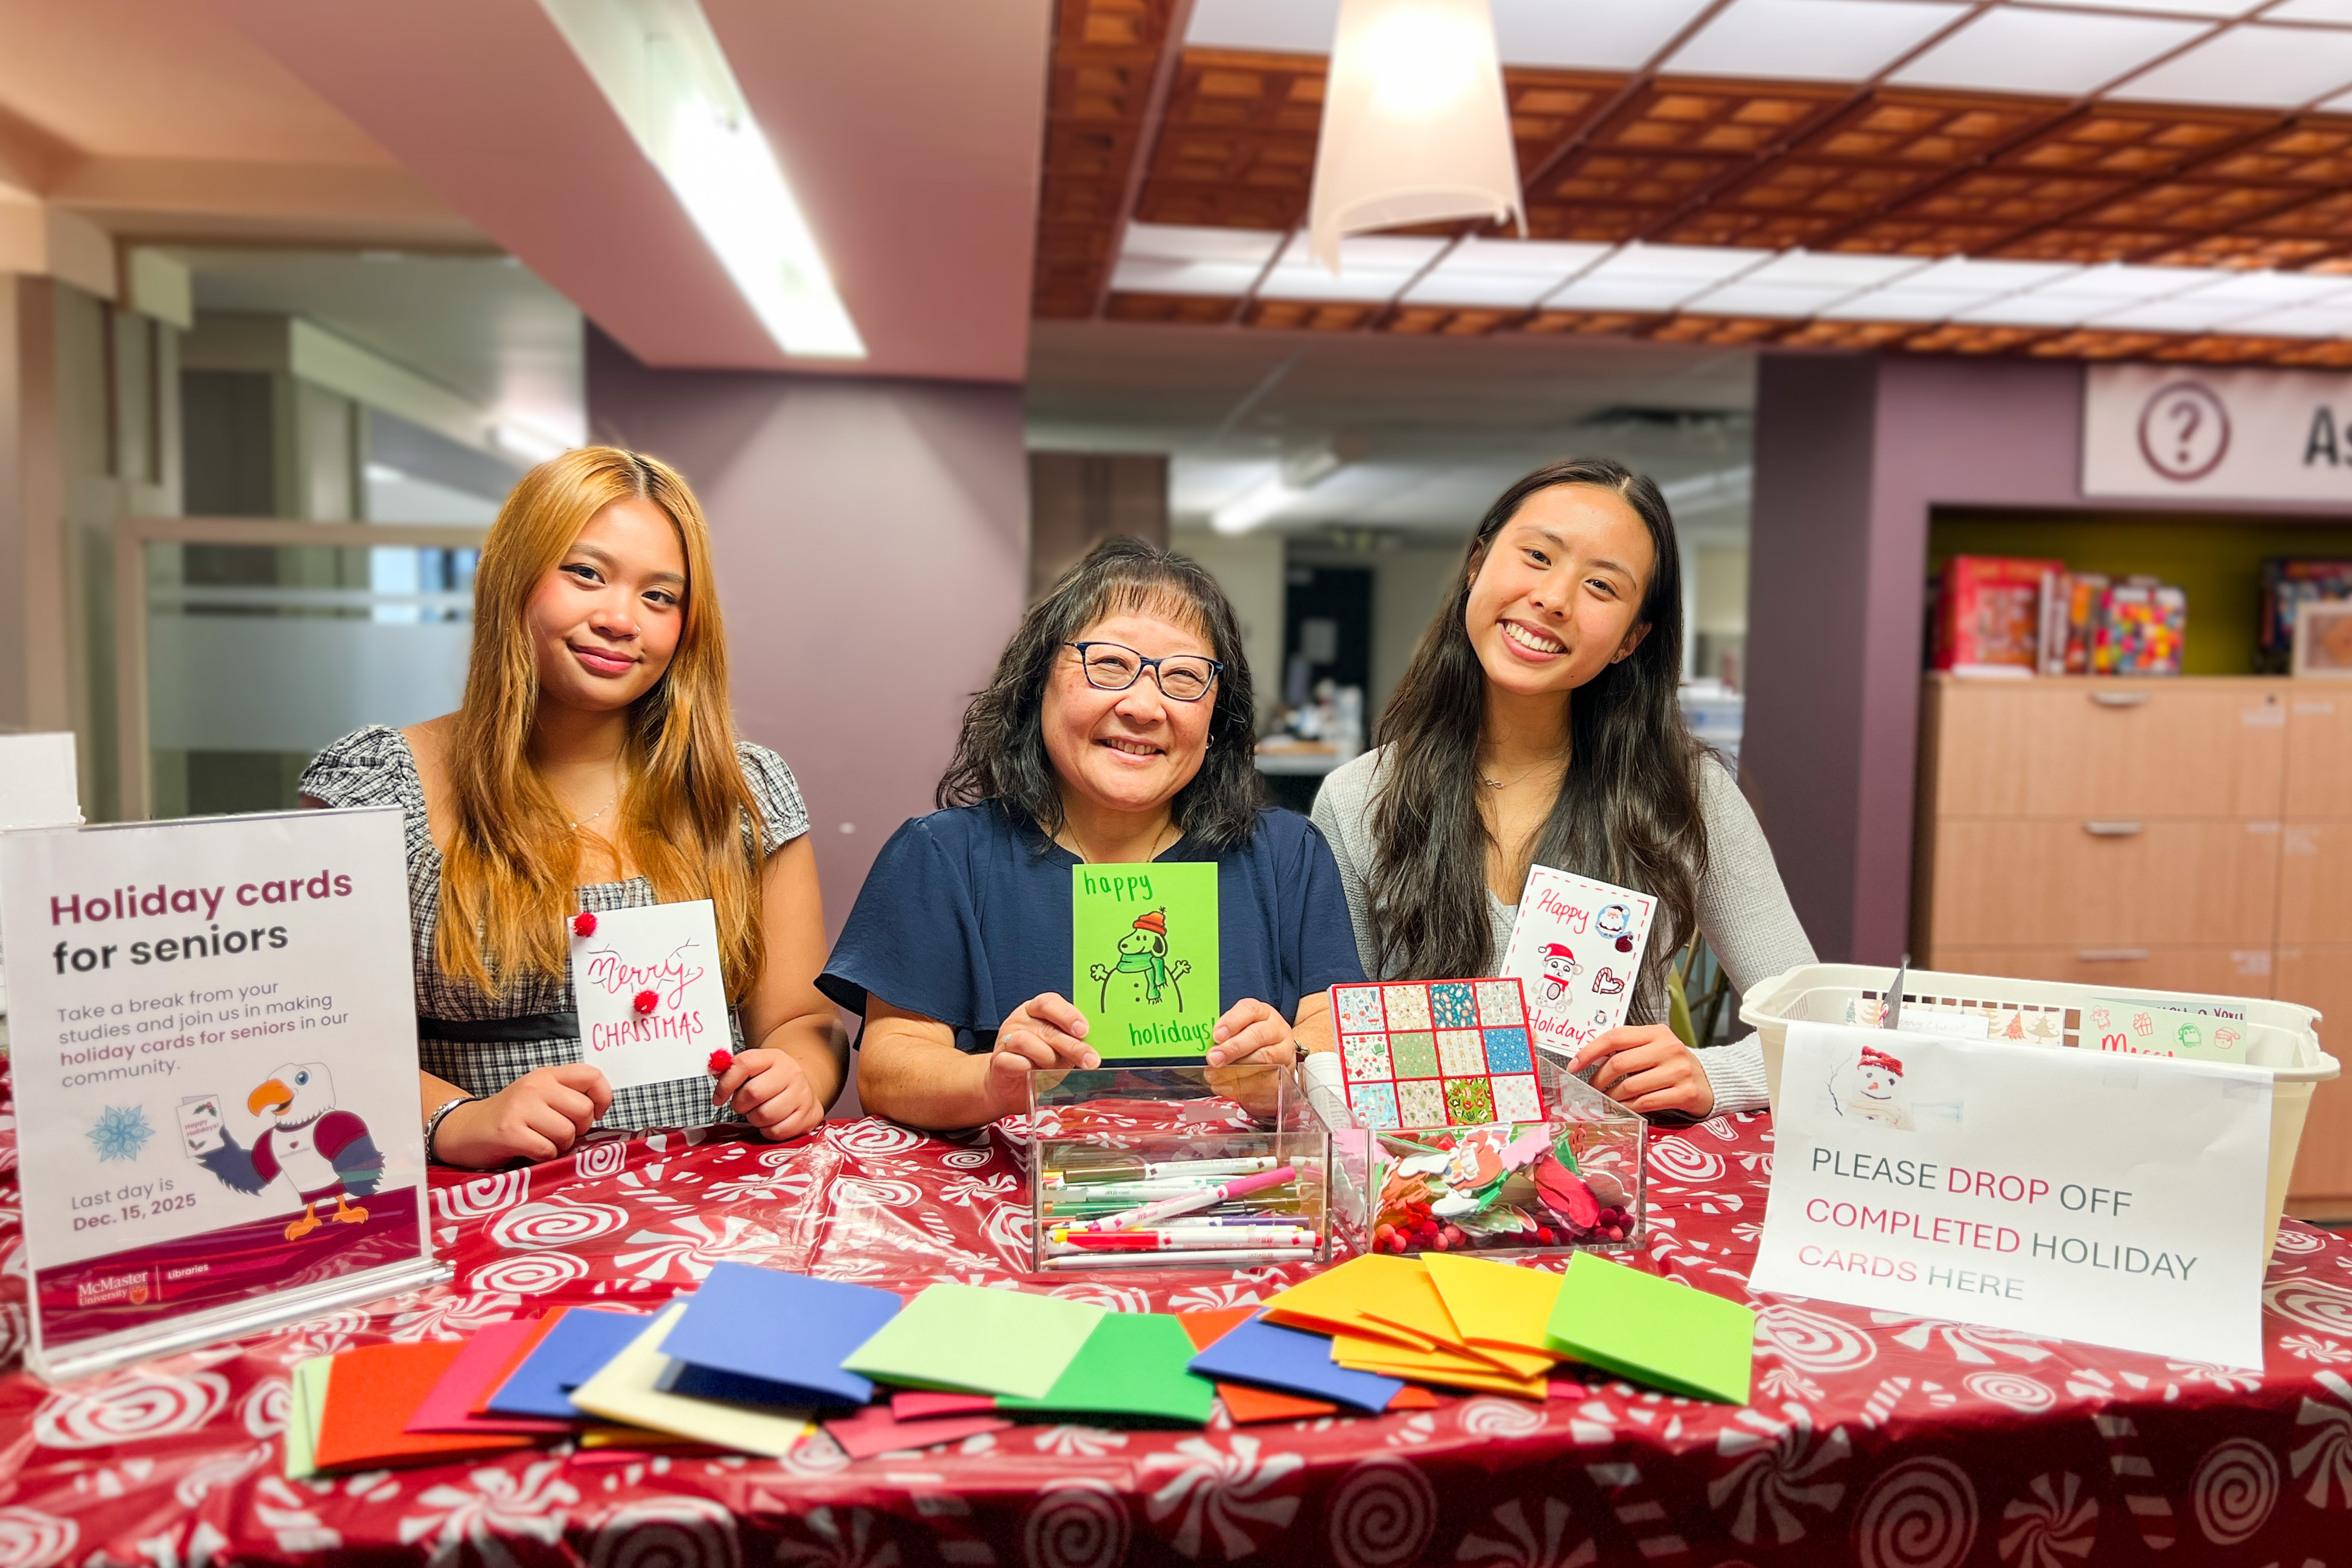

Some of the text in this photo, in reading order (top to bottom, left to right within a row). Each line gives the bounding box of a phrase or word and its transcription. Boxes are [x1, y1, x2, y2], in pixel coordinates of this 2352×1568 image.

[50, 869, 352, 926] Holiday cards
[1084, 871, 1153, 901] happy
[1537, 889, 1589, 934] Happy
[52, 924, 288, 975] for seniors
[57, 982, 279, 1023] Take a break from your
[59, 994, 332, 1044] studies and join us in making
[60, 1011, 349, 1067] holiday cards for seniors in our
[593, 1011, 703, 1051] CHRISTMAS
[62, 1059, 181, 1088] community.
[185, 1119, 208, 1131] Happy
[186, 1123, 220, 1137] Holidays!
[72, 1178, 174, 1210] Last day is
[1812, 1147, 2132, 1217] PLEASE DROP OFF
[73, 1193, 197, 1231] Dec. 15, 2025
[1807, 1198, 2198, 1281] COMPLETED HOLIDAY
[78, 1263, 209, 1297] McMaster Libraries
[1798, 1245, 2025, 1301] CARDS HERE
[78, 1288, 128, 1306] University
